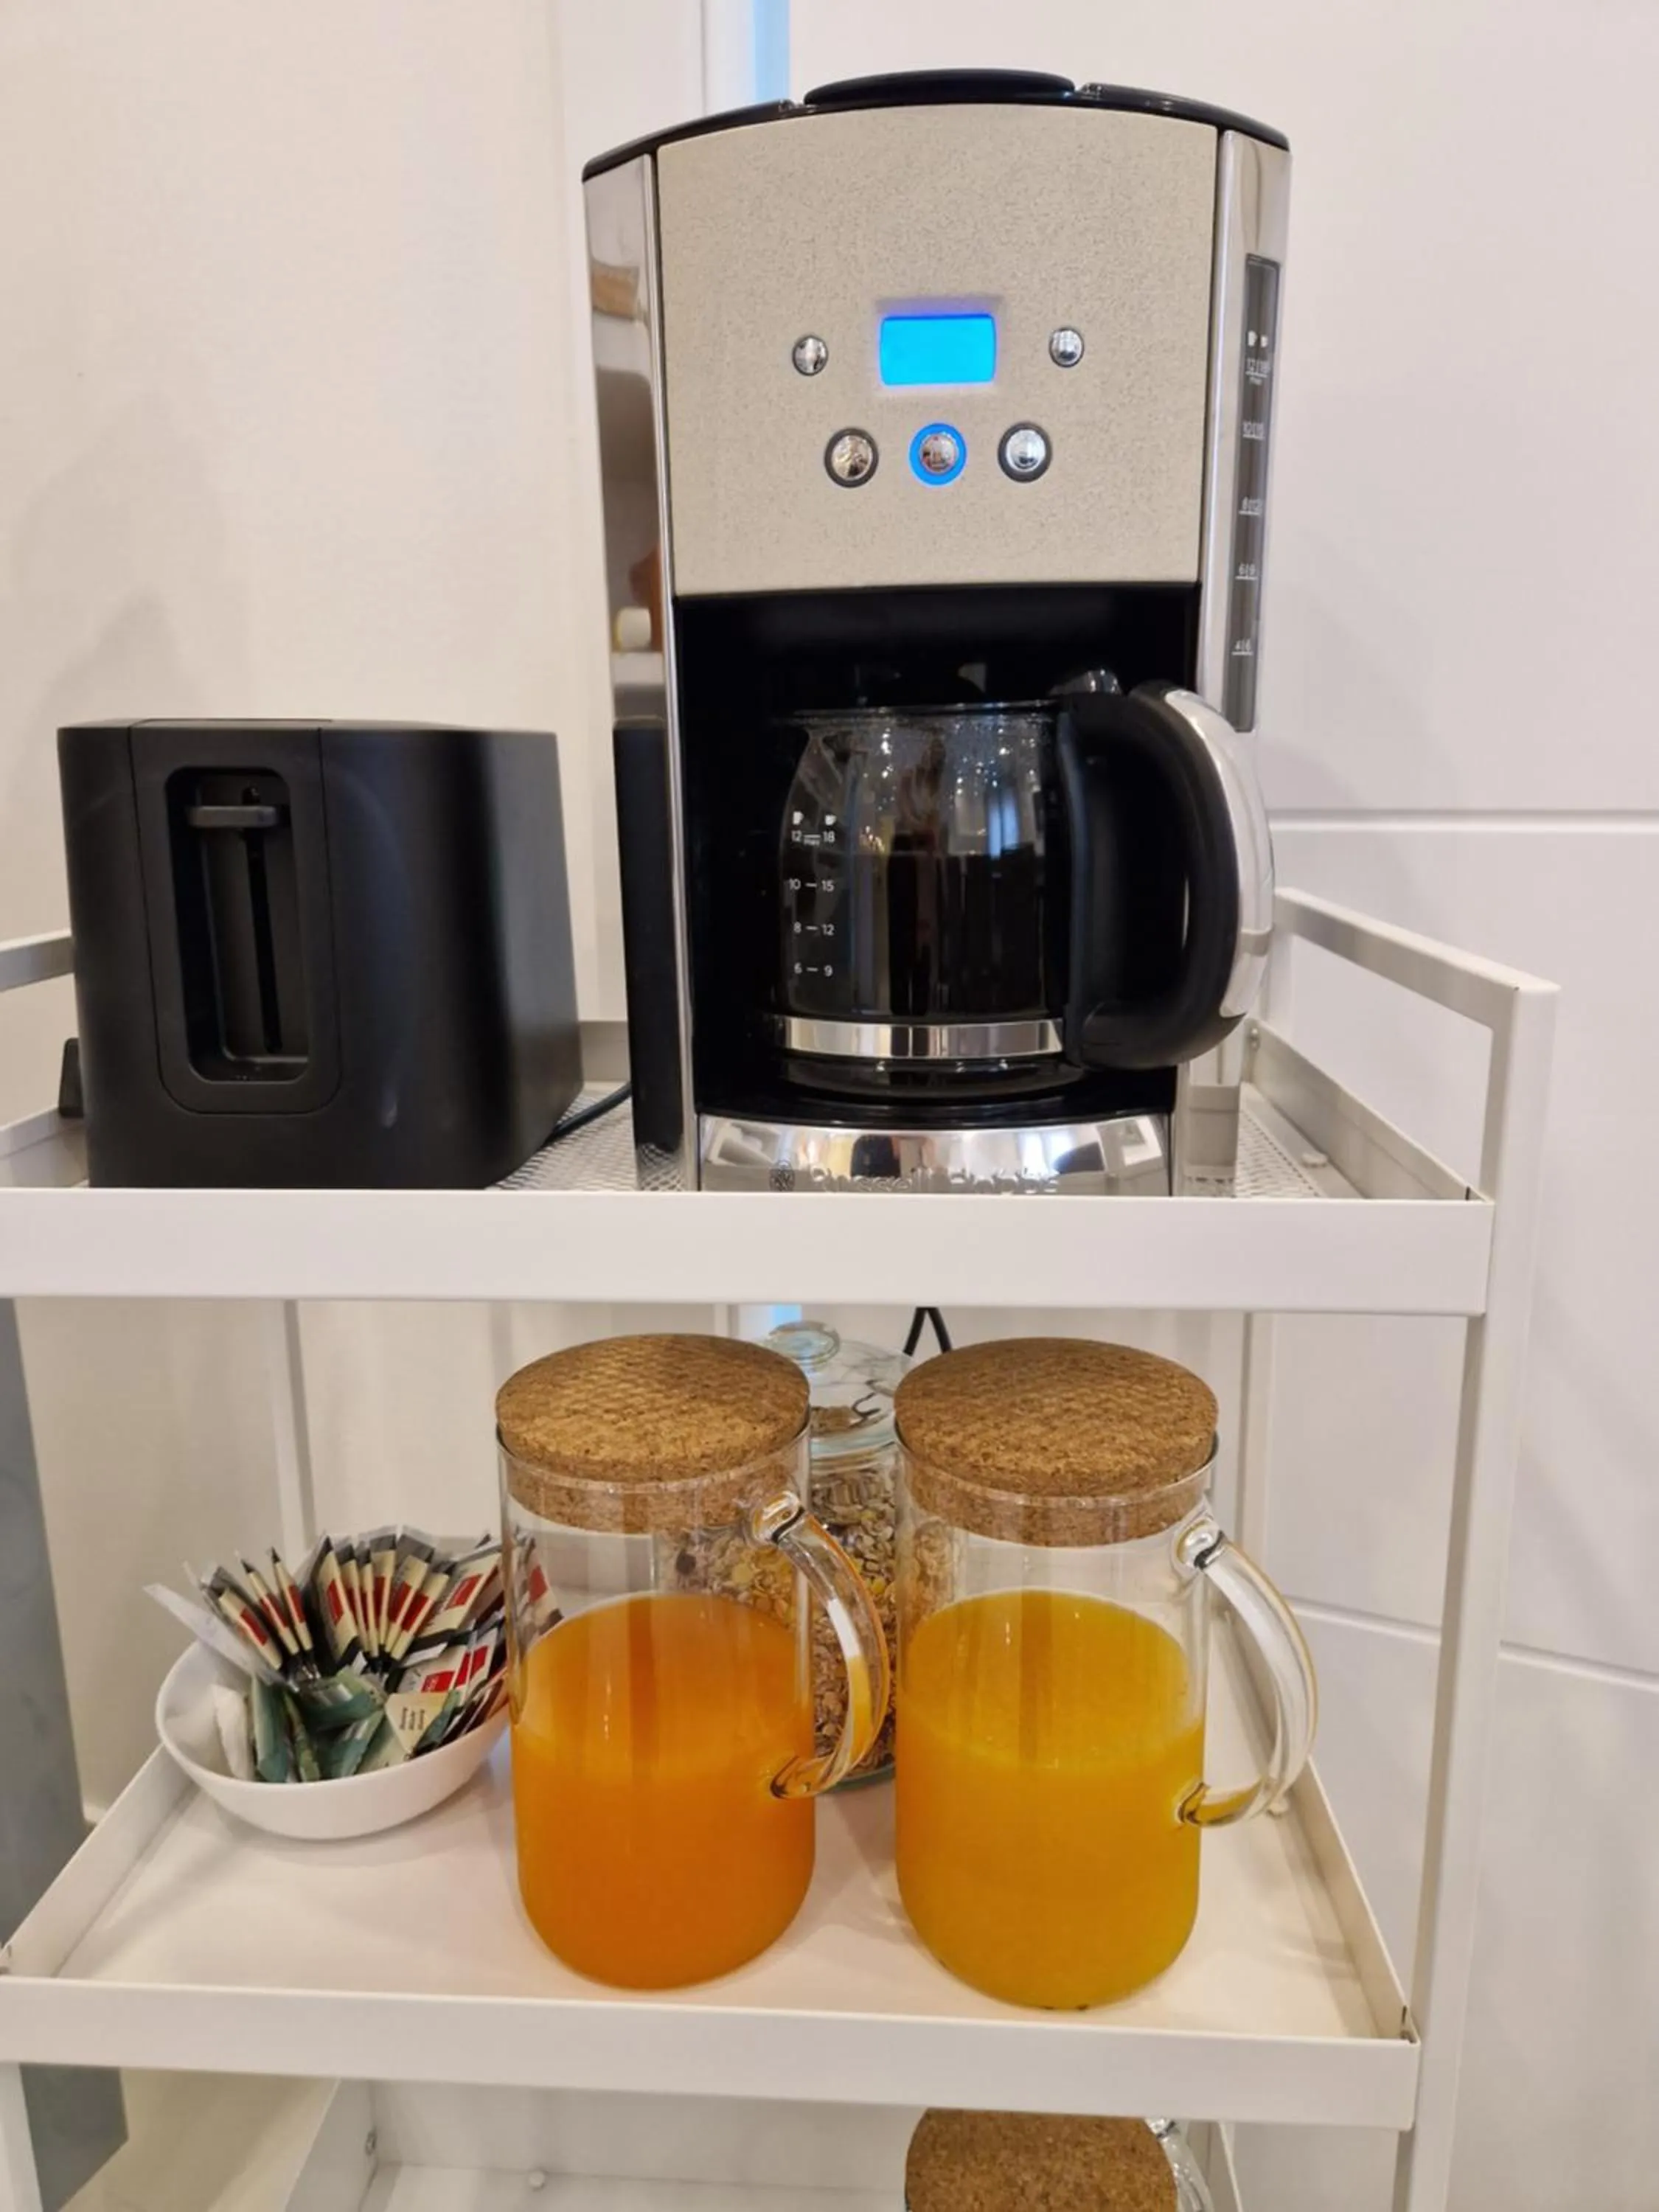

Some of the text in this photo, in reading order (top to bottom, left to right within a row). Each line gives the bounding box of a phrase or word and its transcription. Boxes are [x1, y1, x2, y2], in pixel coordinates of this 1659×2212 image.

[791, 830, 835, 843] 12 18
[789, 878, 835, 891] 10 15
[793, 922, 835, 936] 8 12
[794, 962, 833, 976] 6 9
